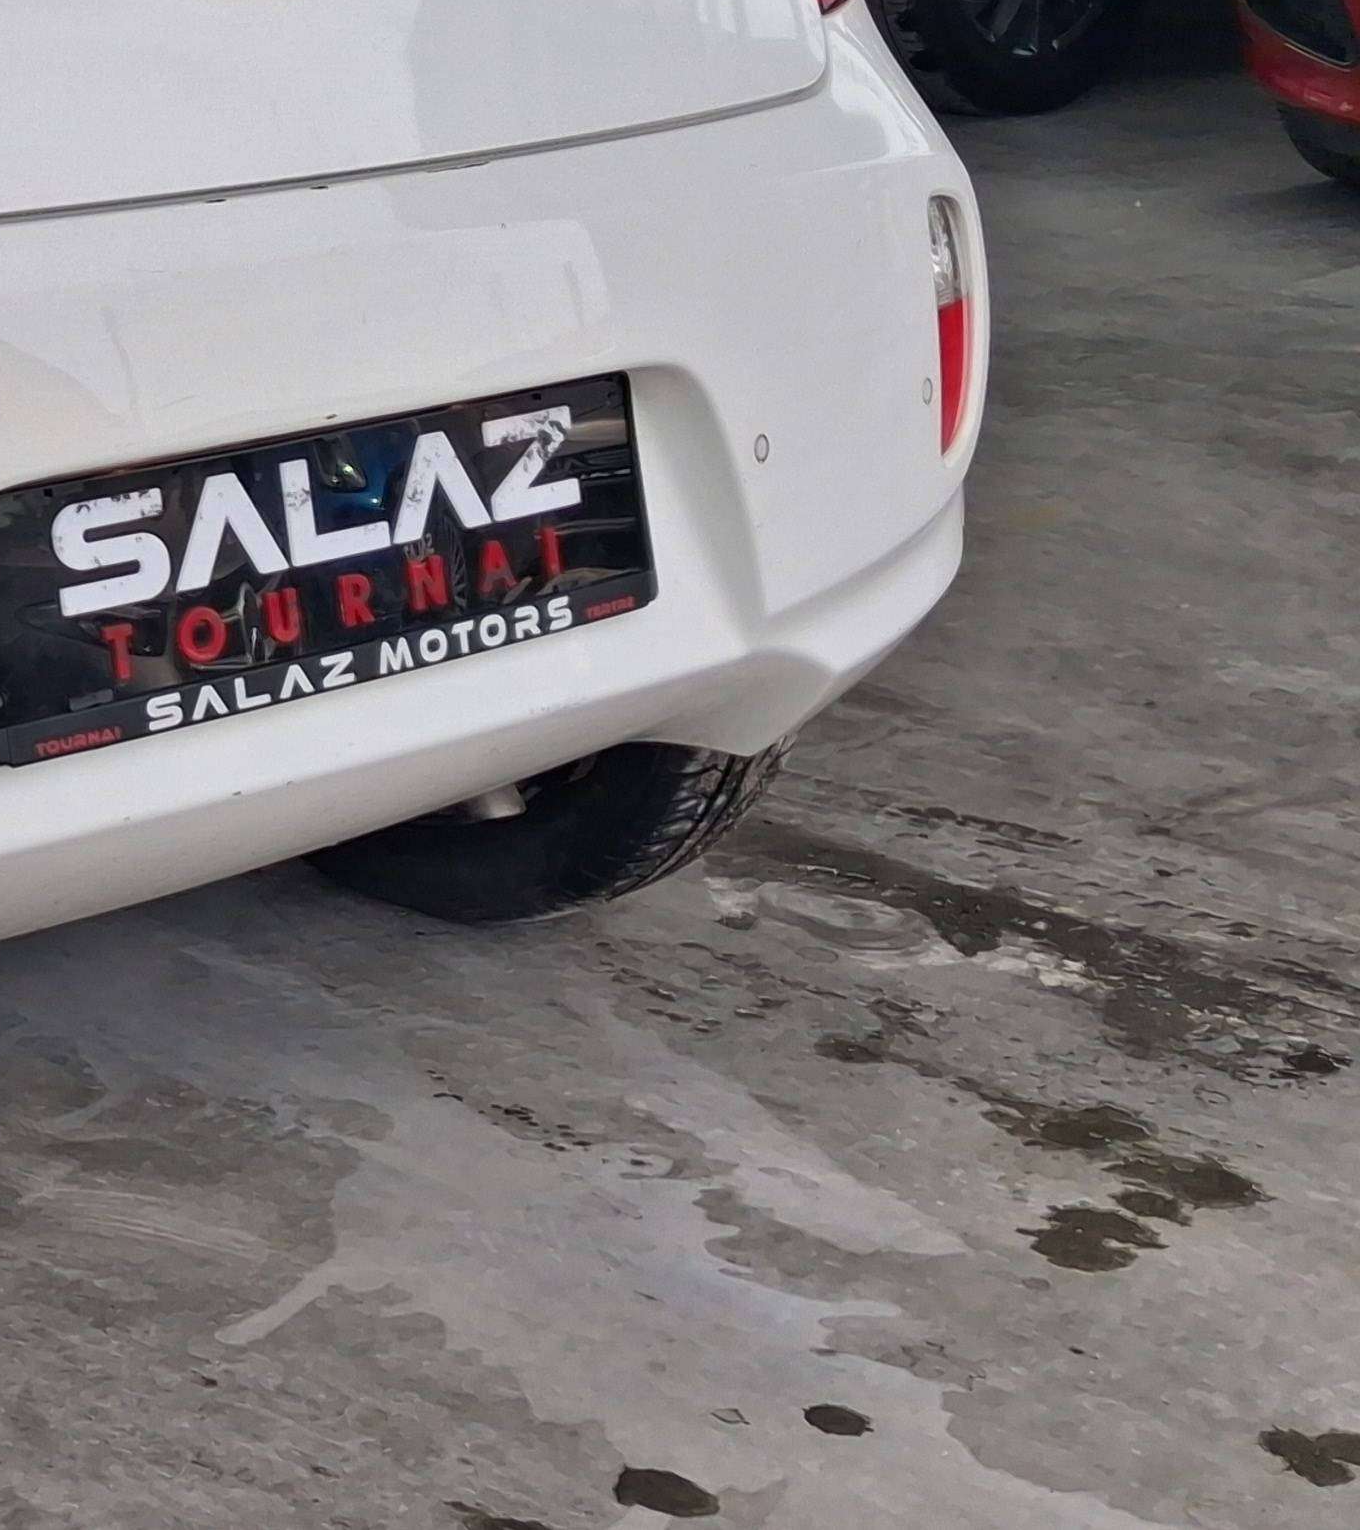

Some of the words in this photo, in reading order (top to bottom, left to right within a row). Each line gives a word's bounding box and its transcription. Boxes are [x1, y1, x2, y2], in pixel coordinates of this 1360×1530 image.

[51, 404, 582, 618] SALAZ
[34, 725, 123, 758] TOURNAI
[145, 651, 358, 734] SALAZ
[380, 594, 574, 676] MOTORS
[100, 525, 564, 682] TOURNAI
